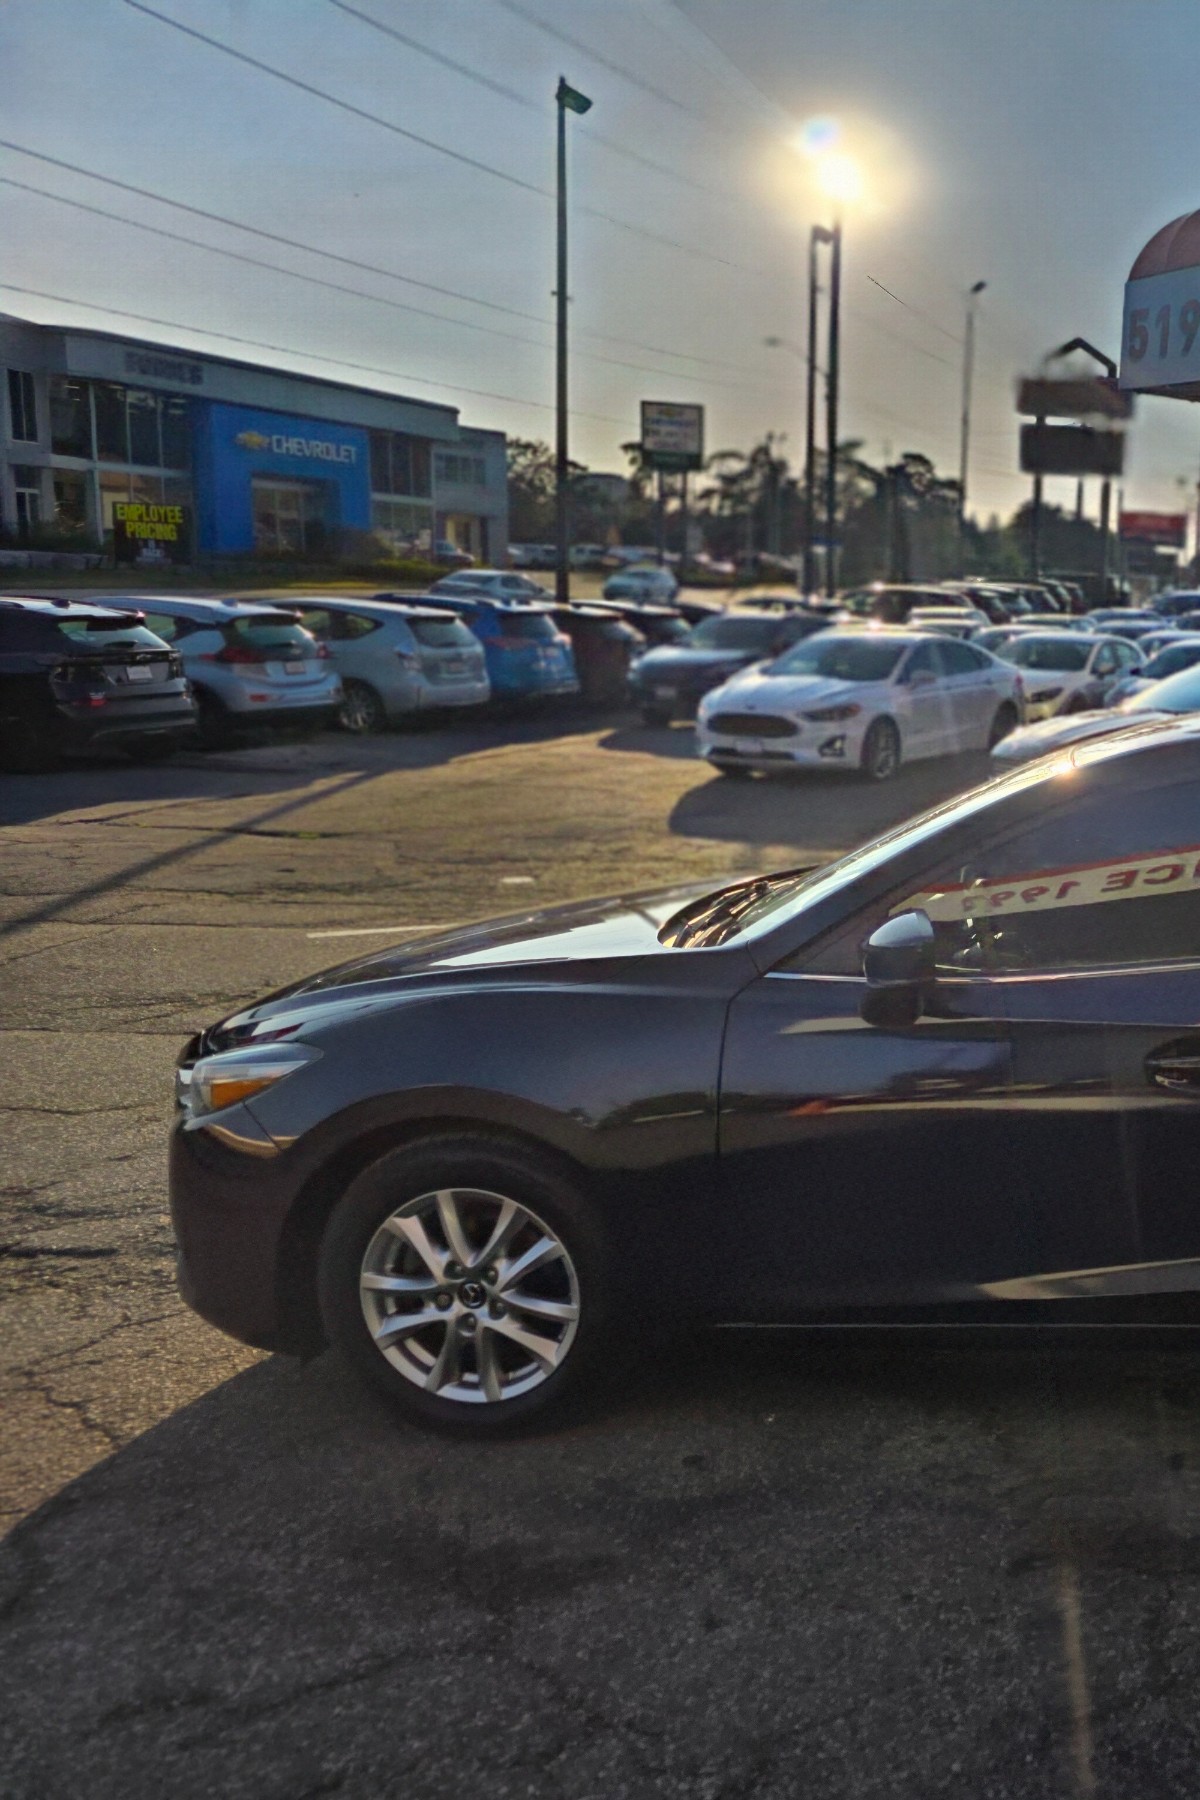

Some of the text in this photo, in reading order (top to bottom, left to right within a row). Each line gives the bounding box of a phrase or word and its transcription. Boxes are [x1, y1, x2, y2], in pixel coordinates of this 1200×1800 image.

[271, 435, 357, 463] CHEVROLET
[116, 503, 183, 523] EMPLOYEE
[126, 521, 177, 540] PRICING
